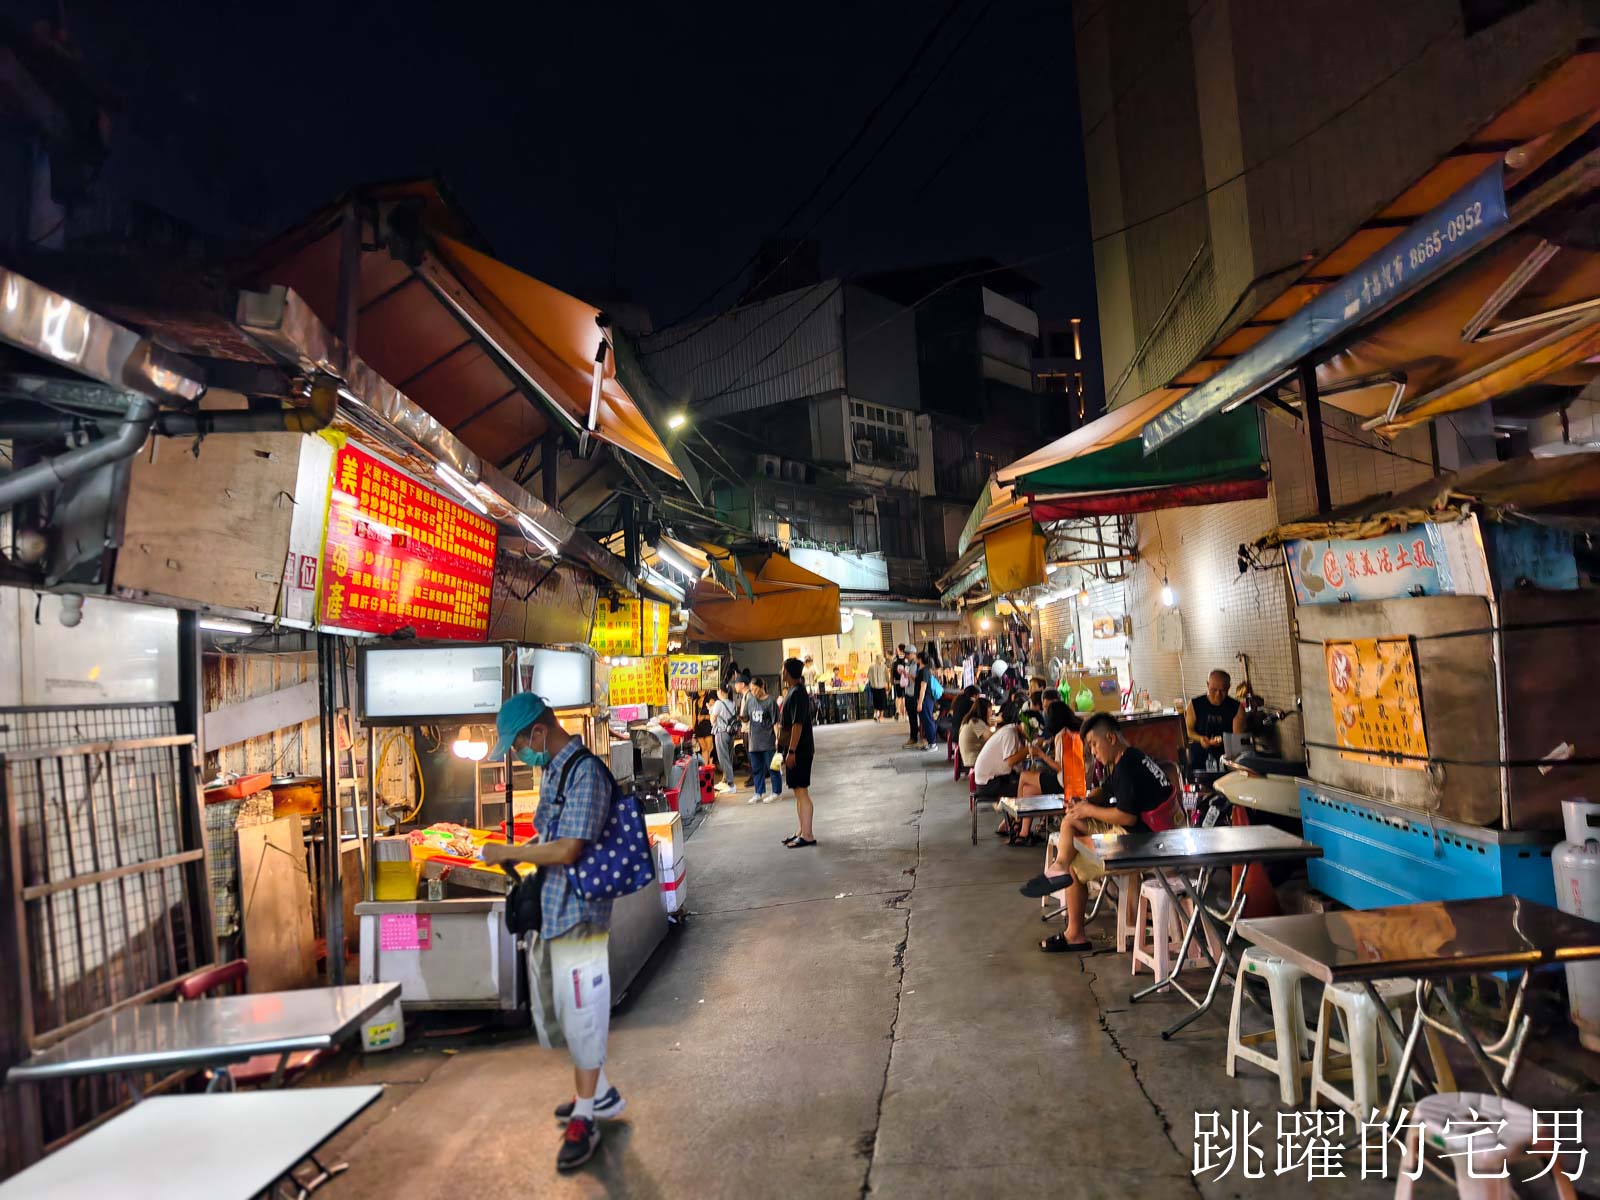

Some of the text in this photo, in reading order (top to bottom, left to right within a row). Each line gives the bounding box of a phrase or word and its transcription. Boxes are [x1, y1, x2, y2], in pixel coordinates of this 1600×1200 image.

[1409, 201, 1482, 269] 8665-0952
[1345, 540, 1434, 578] 景美活土虱
[671, 662, 698, 674] 728
